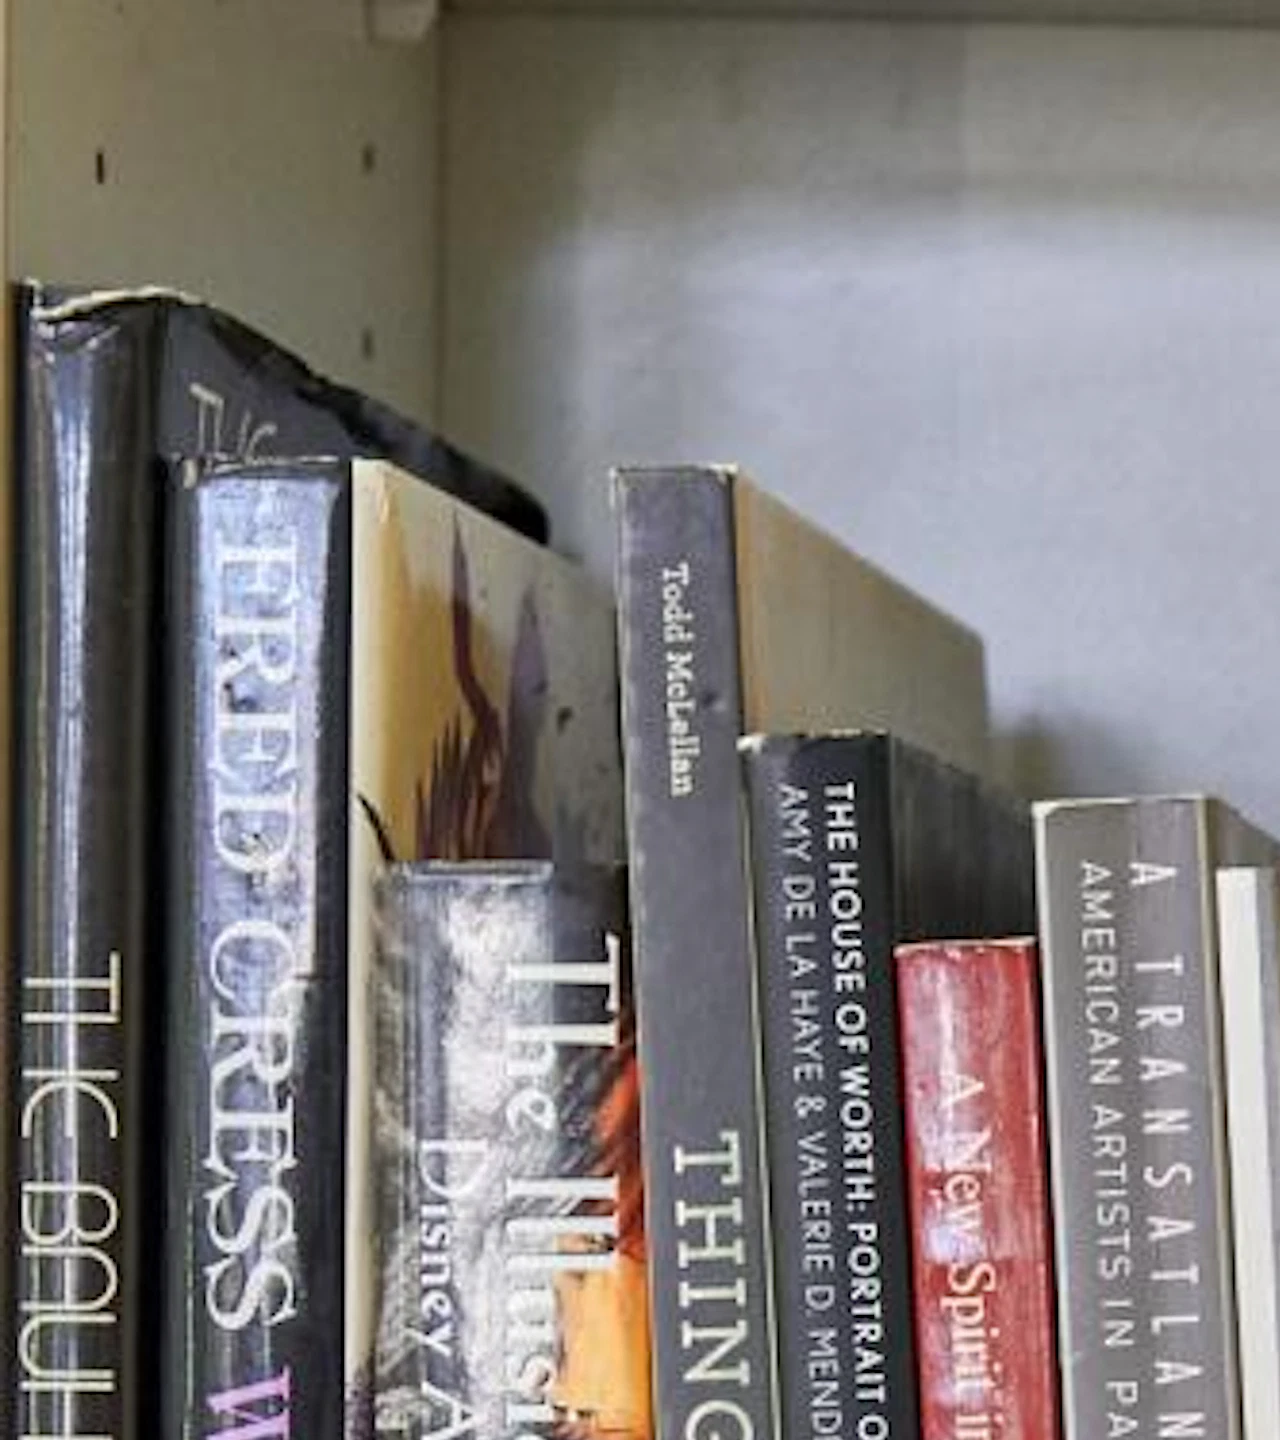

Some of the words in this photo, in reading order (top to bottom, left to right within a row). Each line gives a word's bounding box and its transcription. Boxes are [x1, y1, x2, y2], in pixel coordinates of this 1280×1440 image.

[662, 562, 693, 641] Todd
[213, 539, 301, 878] FRED
[665, 650, 700, 797] McLellan
[777, 786, 811, 861] AMY
[824, 780, 859, 852] THE
[1131, 861, 1177, 886] A
[781, 874, 814, 920] DE
[786, 932, 818, 981] LA
[831, 861, 866, 995] HOUSE
[505, 932, 621, 1136] The
[788, 990, 824, 1078] HAYE
[834, 1005, 870, 1060] OF
[1080, 861, 1122, 1086] AMERICAN
[208, 921, 297, 1331] CRESS
[797, 1090, 826, 1120] &
[836, 1060, 874, 1218] WORTH:
[936, 1072, 983, 1103] A
[402, 1138, 489, 1355] Disney
[798, 1132, 834, 1271] VALERIE
[940, 1128, 993, 1258] New
[1091, 1100, 1133, 1282] ARTISTS
[805, 1282, 836, 1313] D.
[846, 1222, 887, 1405] PORTRAIT
[940, 1263, 1000, 1387] Spirit
[1101, 1298, 1134, 1347] IN
